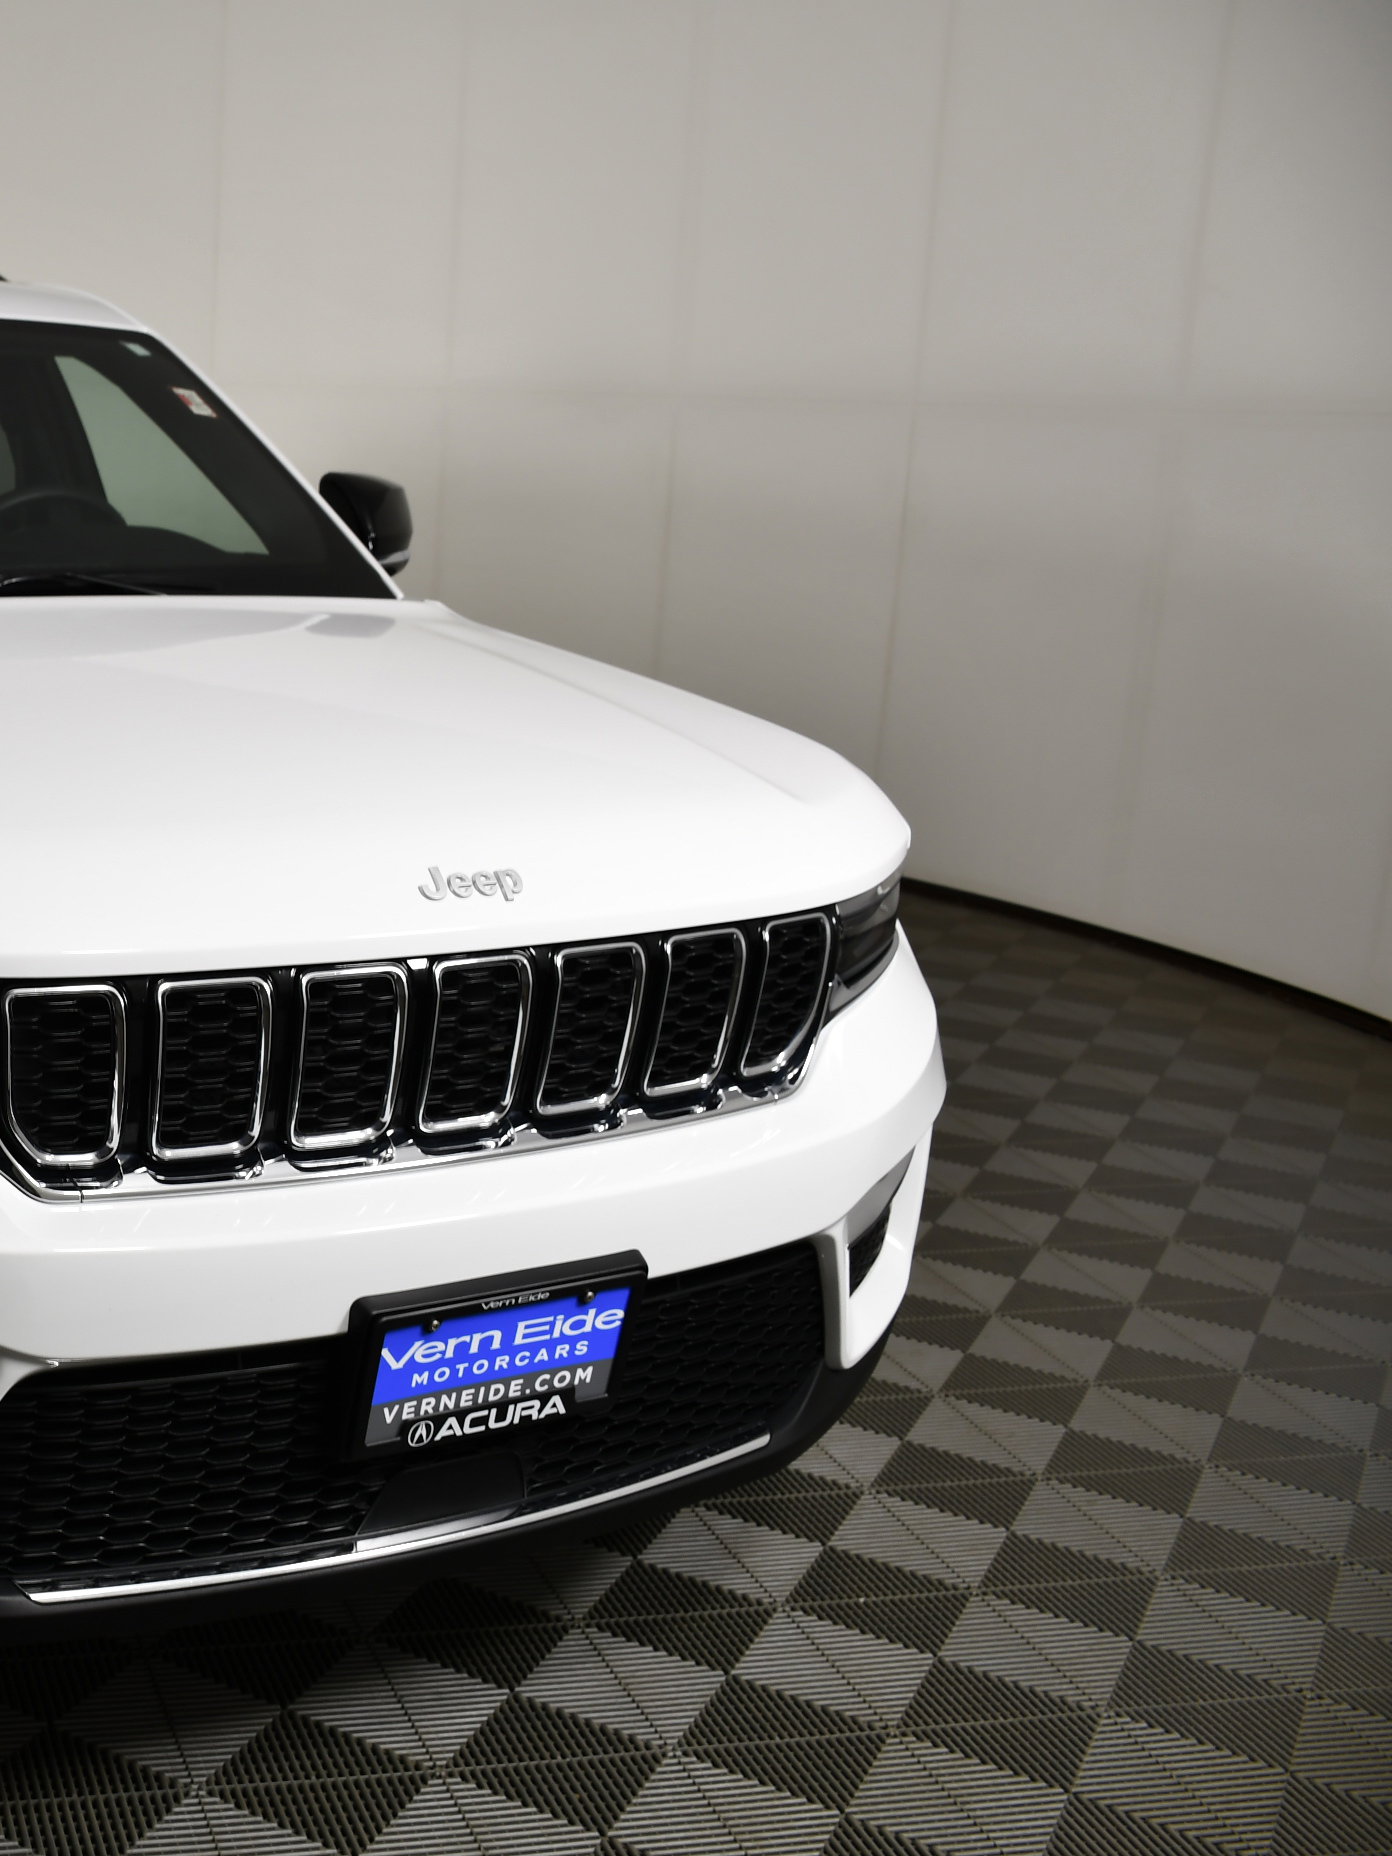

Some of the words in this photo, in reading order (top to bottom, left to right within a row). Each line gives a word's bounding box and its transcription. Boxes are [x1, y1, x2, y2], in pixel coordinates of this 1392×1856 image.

[418, 866, 523, 901] Jeep
[481, 1295, 517, 1311] Vern
[517, 1291, 550, 1305] Eide
[381, 1329, 503, 1370] Vern
[512, 1308, 625, 1346] Eide
[411, 1340, 589, 1388] MOTORCARS
[382, 1365, 594, 1424] VERNEIDE.COM
[434, 1394, 567, 1441] ACURA
